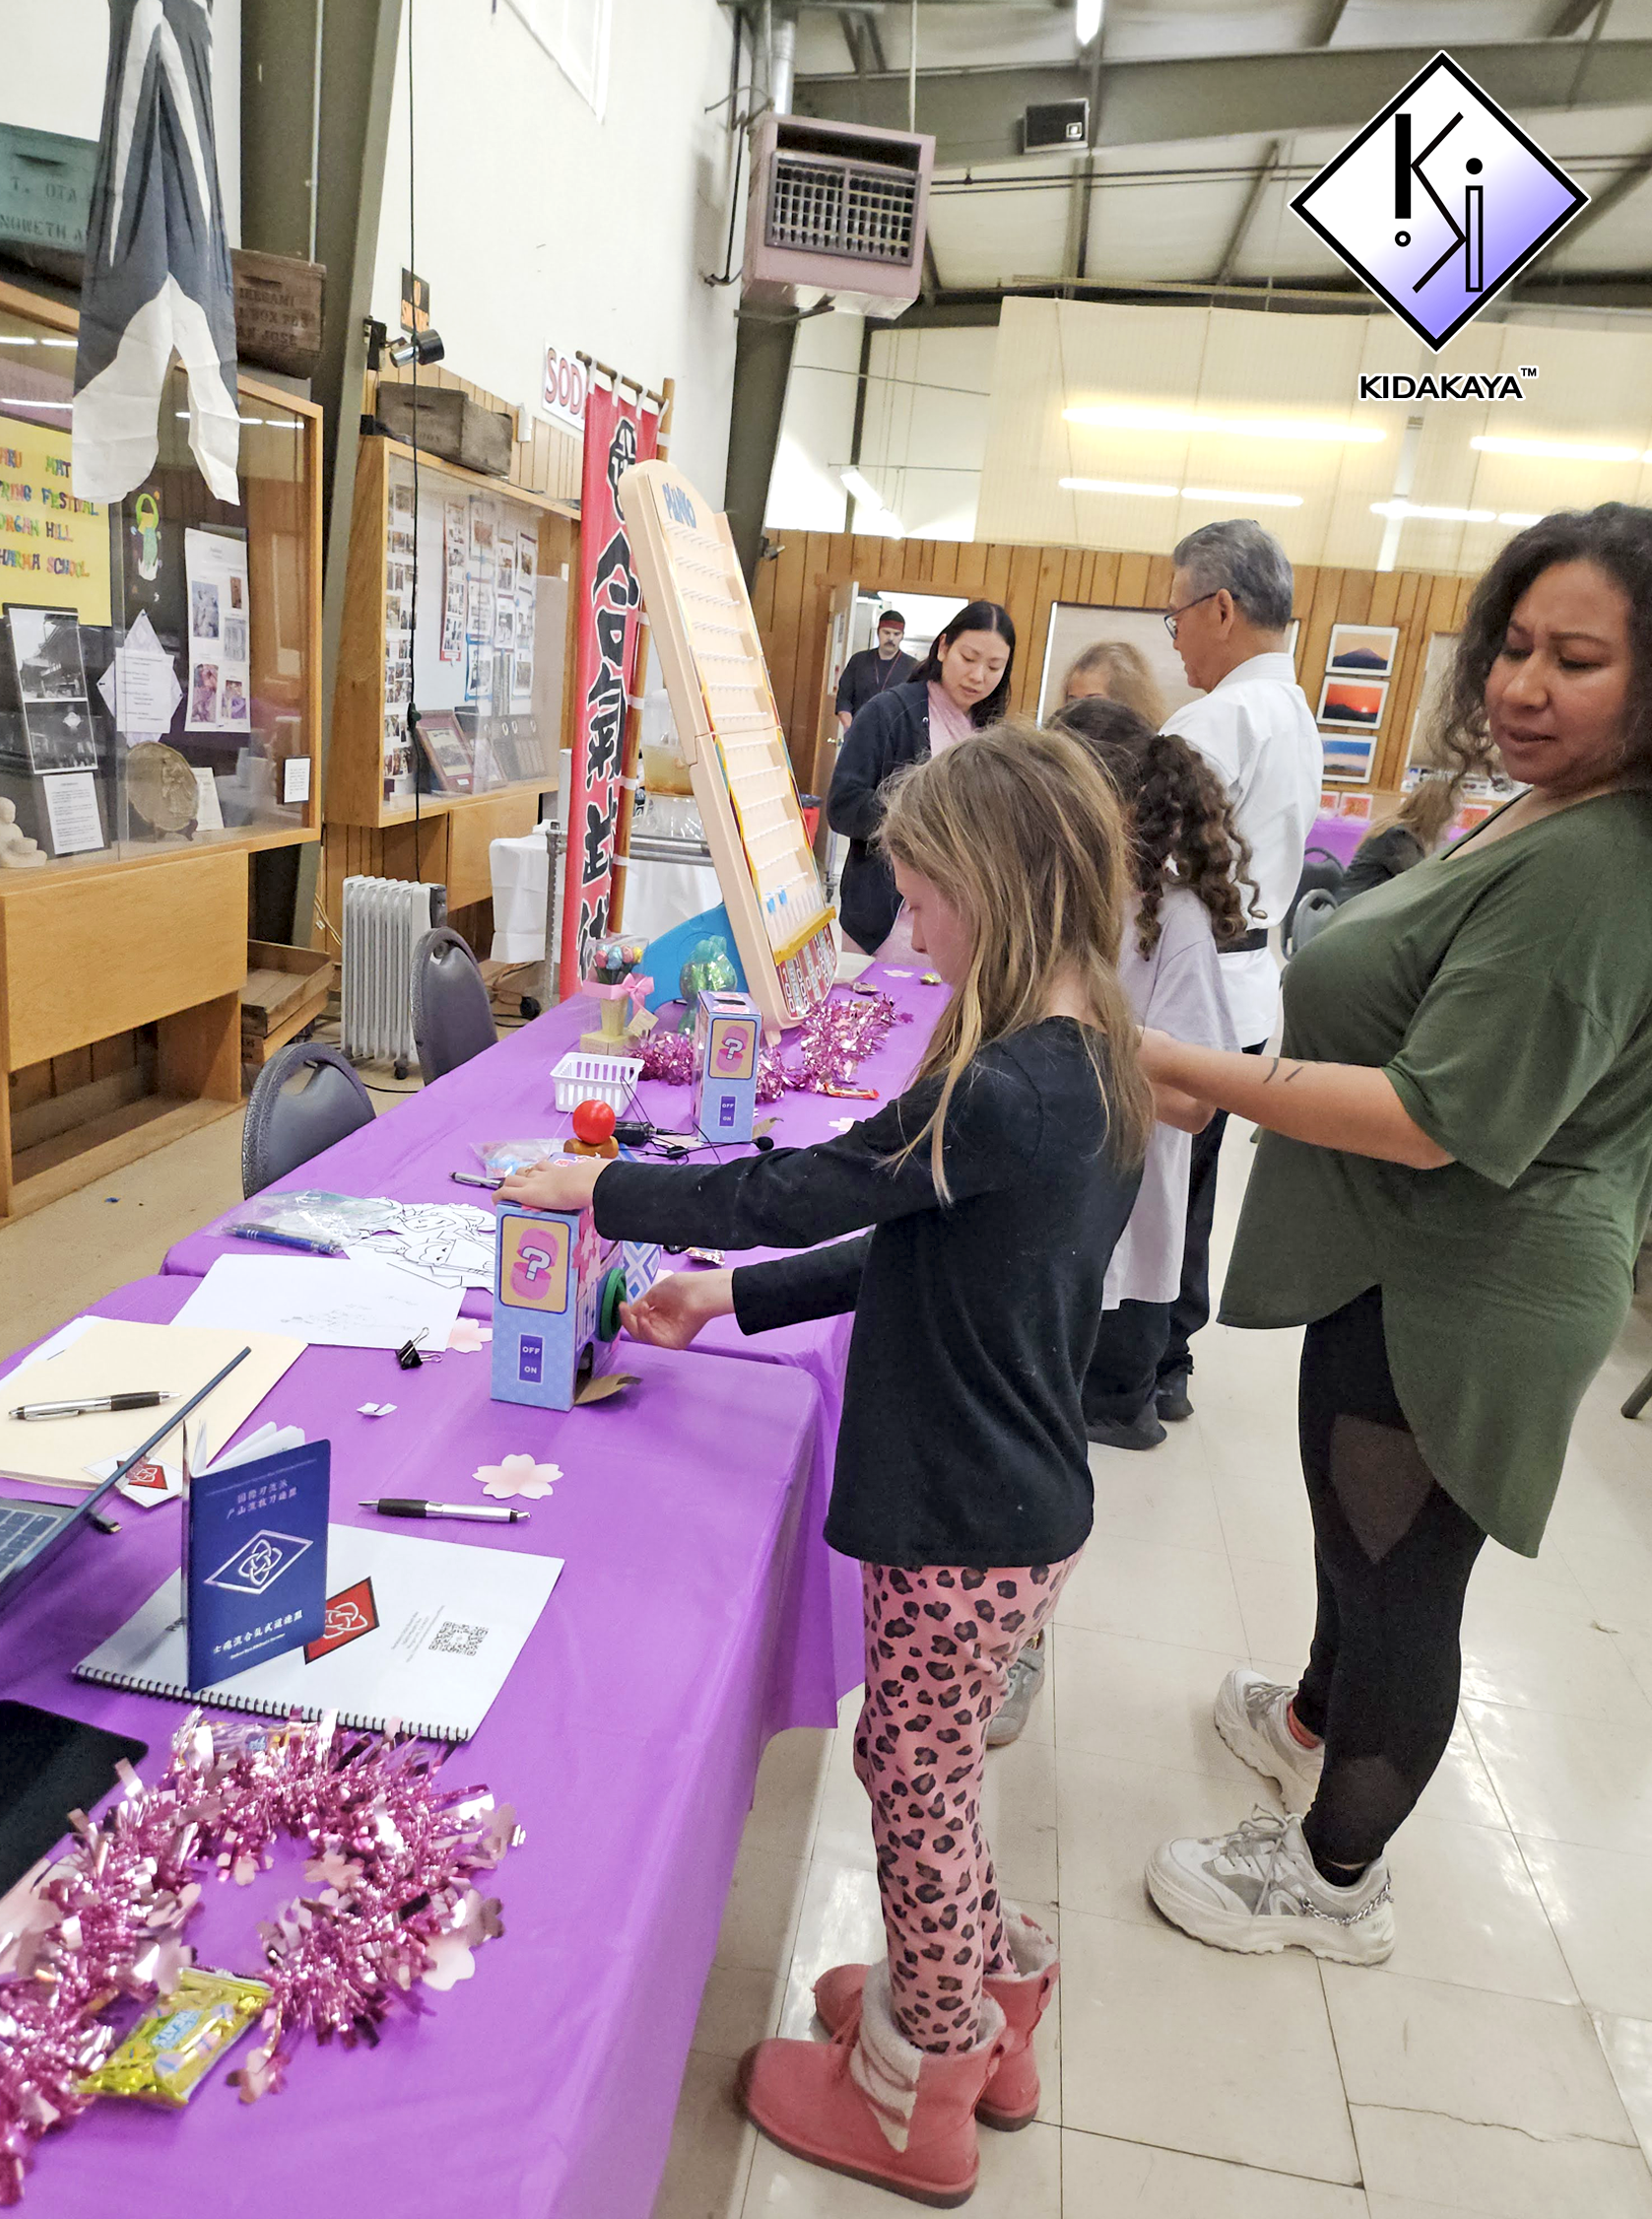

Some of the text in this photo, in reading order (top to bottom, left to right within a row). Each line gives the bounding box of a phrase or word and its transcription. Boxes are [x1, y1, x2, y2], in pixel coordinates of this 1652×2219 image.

[544, 347, 583, 416] SOD
[0, 479, 99, 516] RING FESTIVAL
[45, 521, 74, 543] HILL
[46, 556, 91, 578] SCHOOL
[522, 1346, 541, 1355] OFF
[524, 1366, 538, 1375] ON
